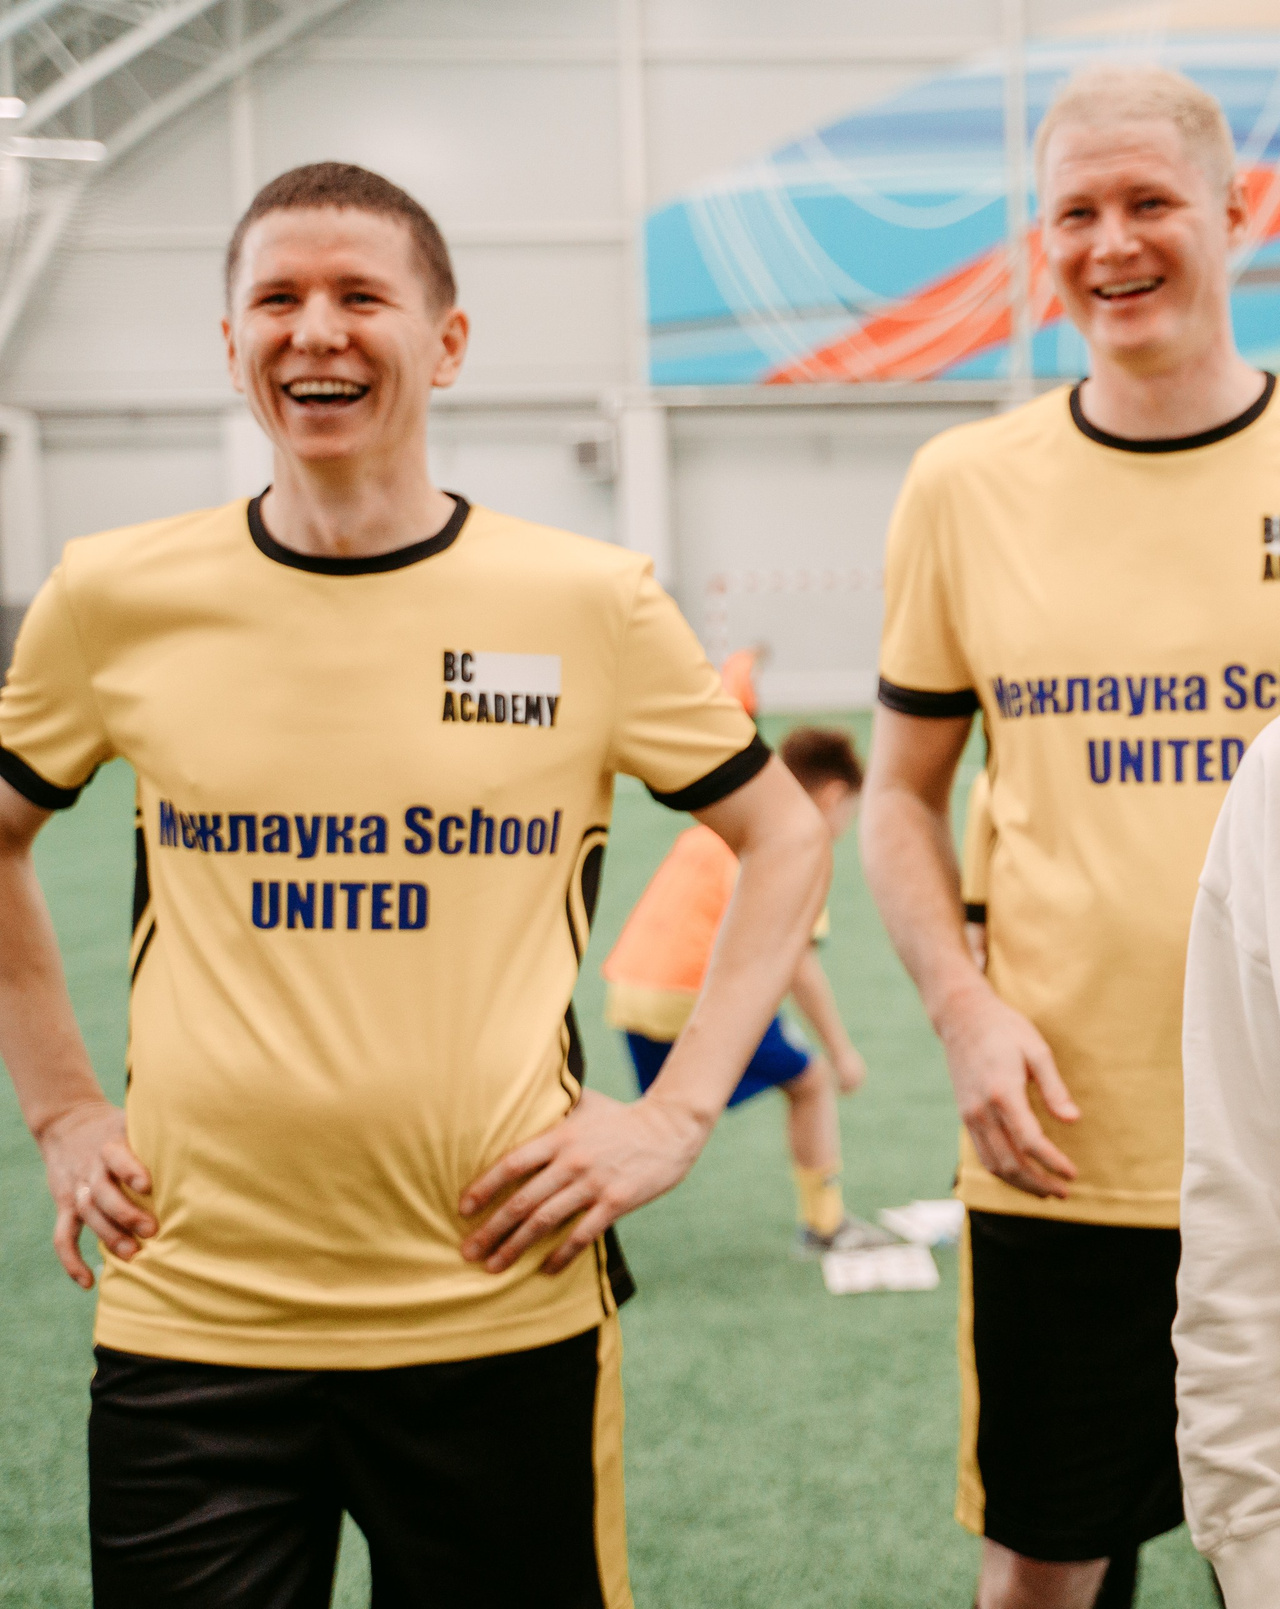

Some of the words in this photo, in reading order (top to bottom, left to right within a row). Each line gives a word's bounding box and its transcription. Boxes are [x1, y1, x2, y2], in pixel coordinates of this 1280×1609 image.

[443, 650, 475, 683] BC
[442, 691, 562, 728] ACADEMY
[1088, 737, 1245, 784] UNITED
[404, 805, 563, 856] School
[251, 880, 431, 931] UNITED
